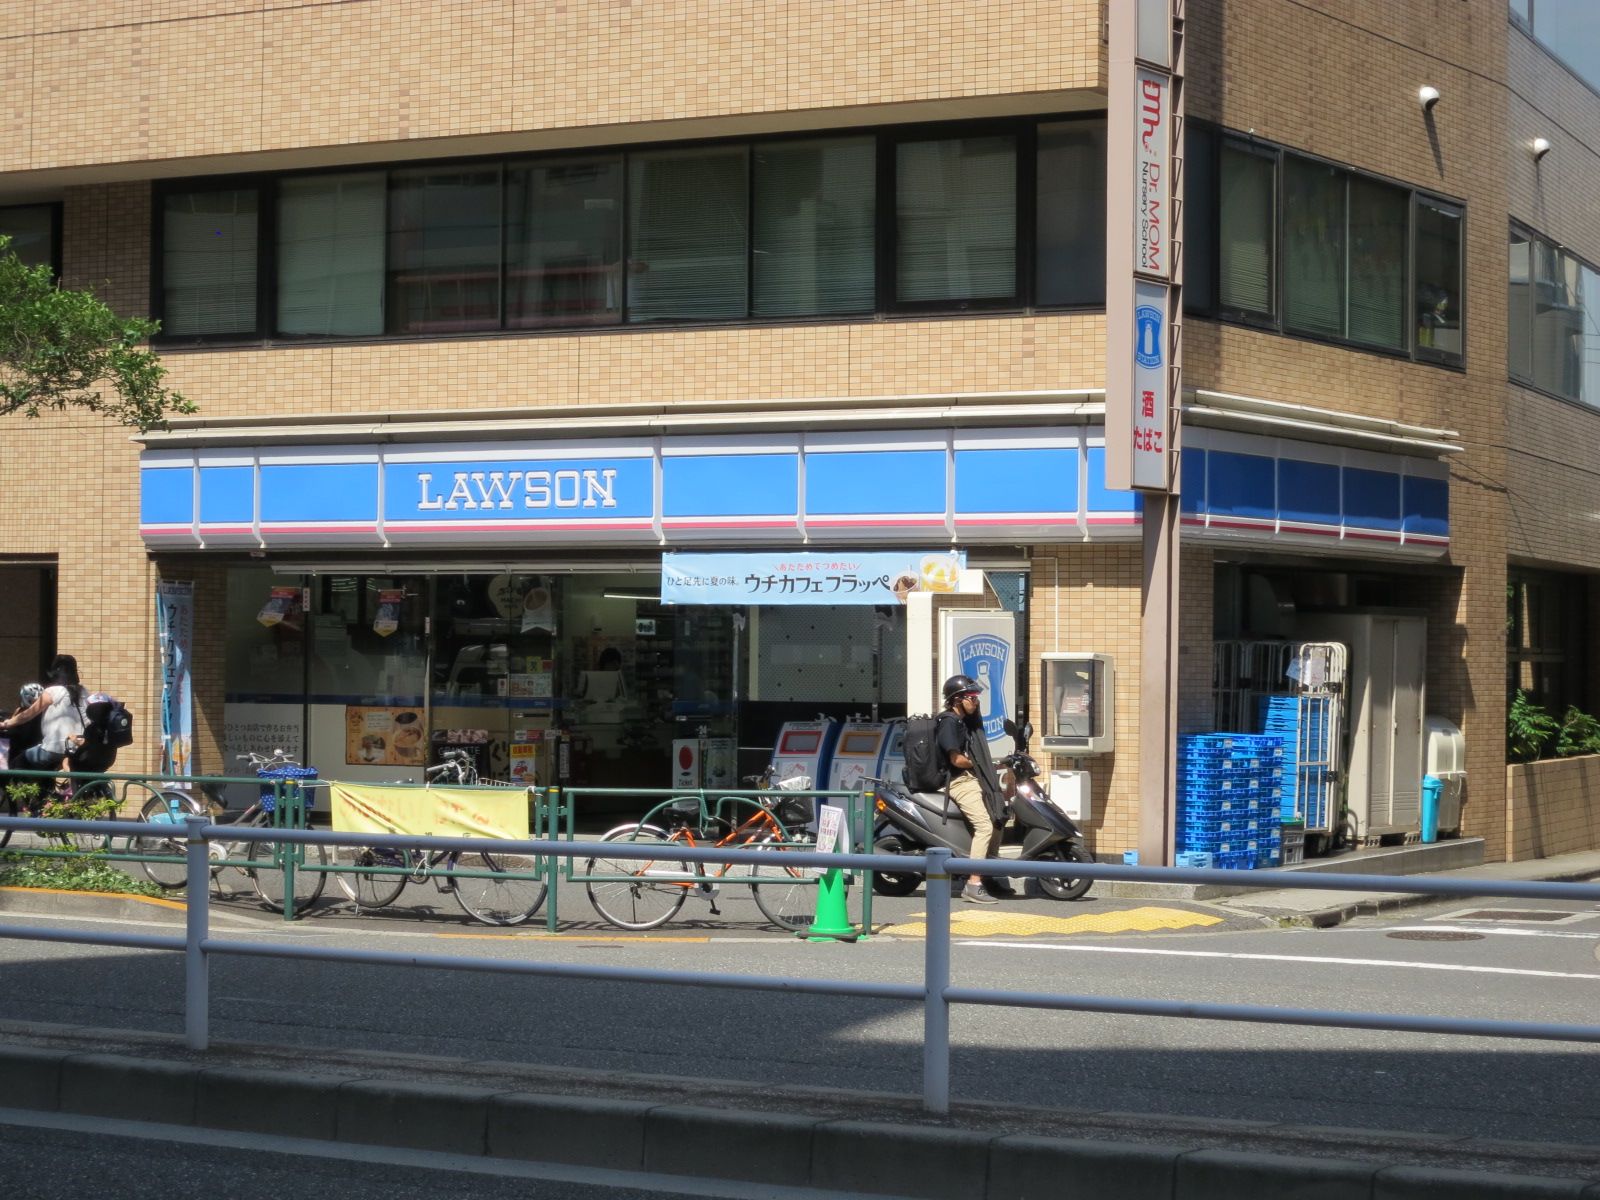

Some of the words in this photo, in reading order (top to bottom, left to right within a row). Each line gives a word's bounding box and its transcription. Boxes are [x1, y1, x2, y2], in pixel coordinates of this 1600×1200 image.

[1139, 160, 1149, 216] Nursery
[1148, 162, 1161, 194] Dr.
[1140, 218, 1149, 269] School
[1148, 200, 1160, 271] MOM
[1142, 390, 1154, 418] 酒
[1133, 426, 1163, 453] たばこ
[417, 468, 617, 510] LAWSON
[779, 562, 856, 573] あたためてつめたい
[744, 573, 890, 594] ウチカフェフラッペ
[962, 642, 1005, 662] LAWSON
